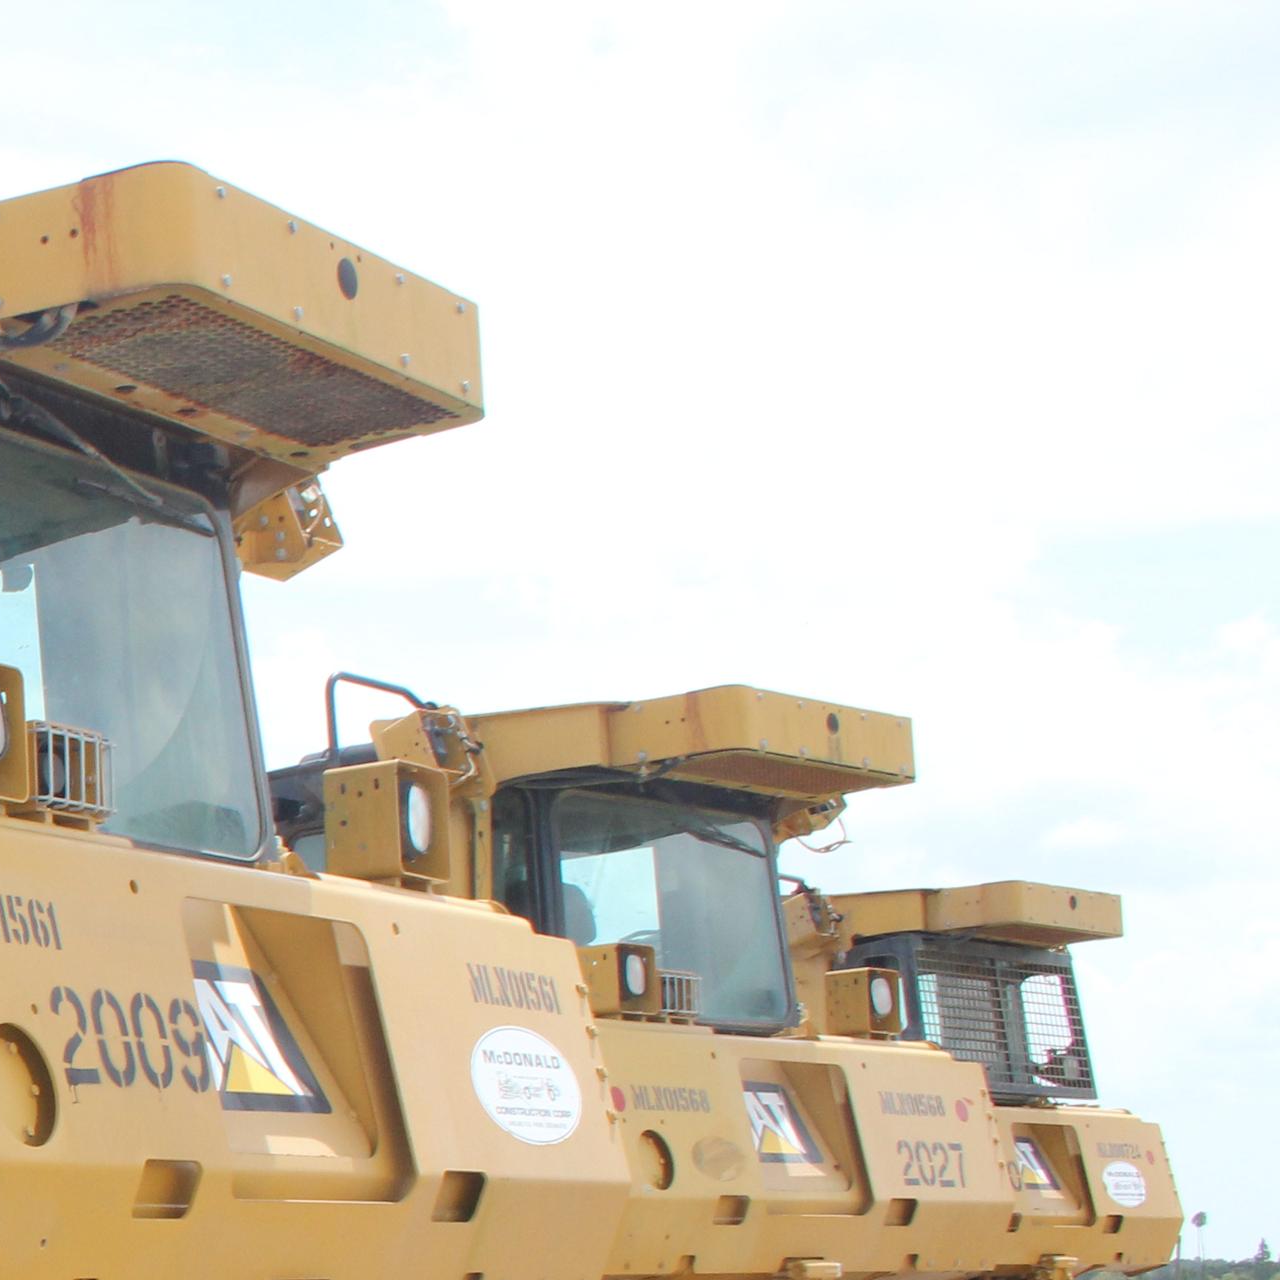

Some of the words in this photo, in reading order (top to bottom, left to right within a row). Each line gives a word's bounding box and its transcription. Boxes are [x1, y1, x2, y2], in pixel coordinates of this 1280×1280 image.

[50, 986, 210, 1093] 2009
[192, 978, 313, 1097] AT
[482, 1049, 561, 1070] McDONALD
[743, 1091, 807, 1154] AT
[896, 1139, 966, 1188] 2027
